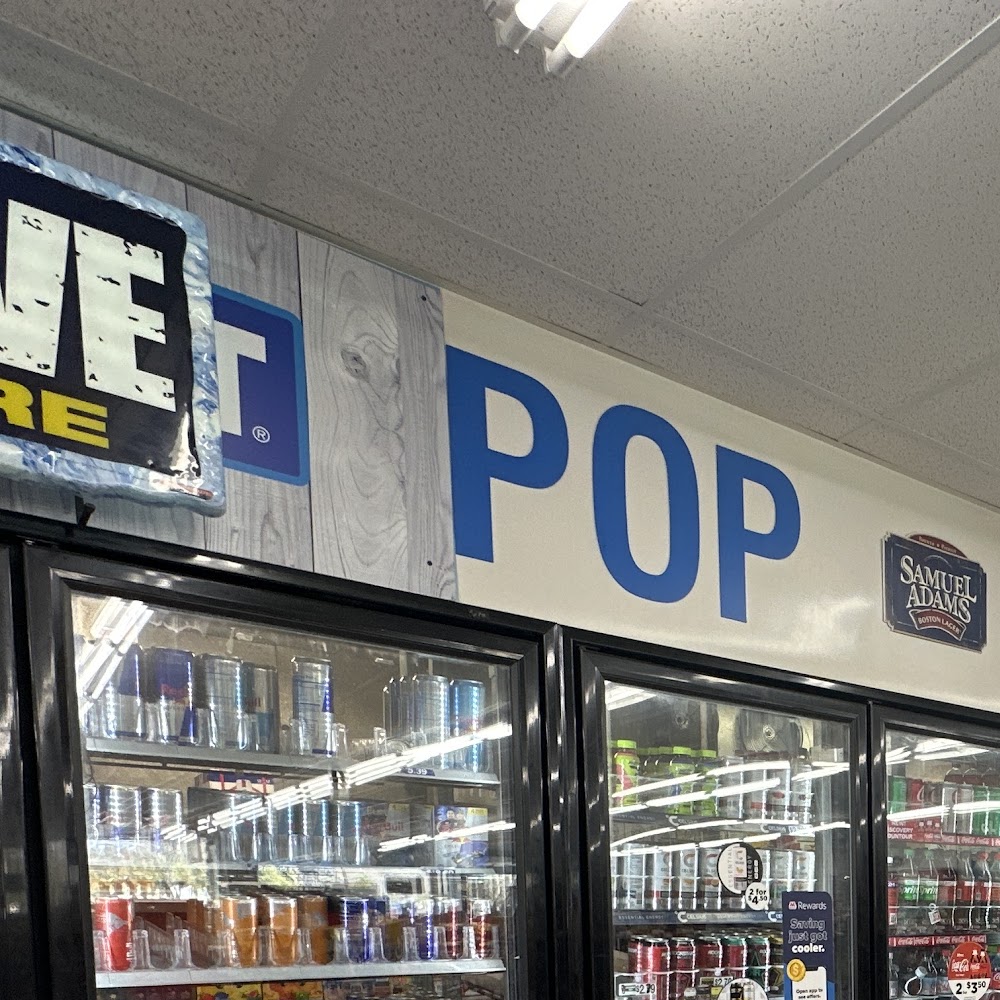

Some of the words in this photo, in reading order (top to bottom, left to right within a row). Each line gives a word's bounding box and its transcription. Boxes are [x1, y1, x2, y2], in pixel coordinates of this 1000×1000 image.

[446, 344, 801, 623] POP
[900, 555, 977, 604] SAMUEL
[906, 584, 971, 624] ADAMS
[917, 612, 941, 627] BOSTON
[941, 617, 961, 635] LAGER
[798, 901, 827, 910] Rewards
[790, 918, 825, 931] Saving
[788, 931, 809, 943] just
[810, 930, 827, 942] got
[792, 943, 825, 953] cooler.
[955, 983, 962, 994] 2
